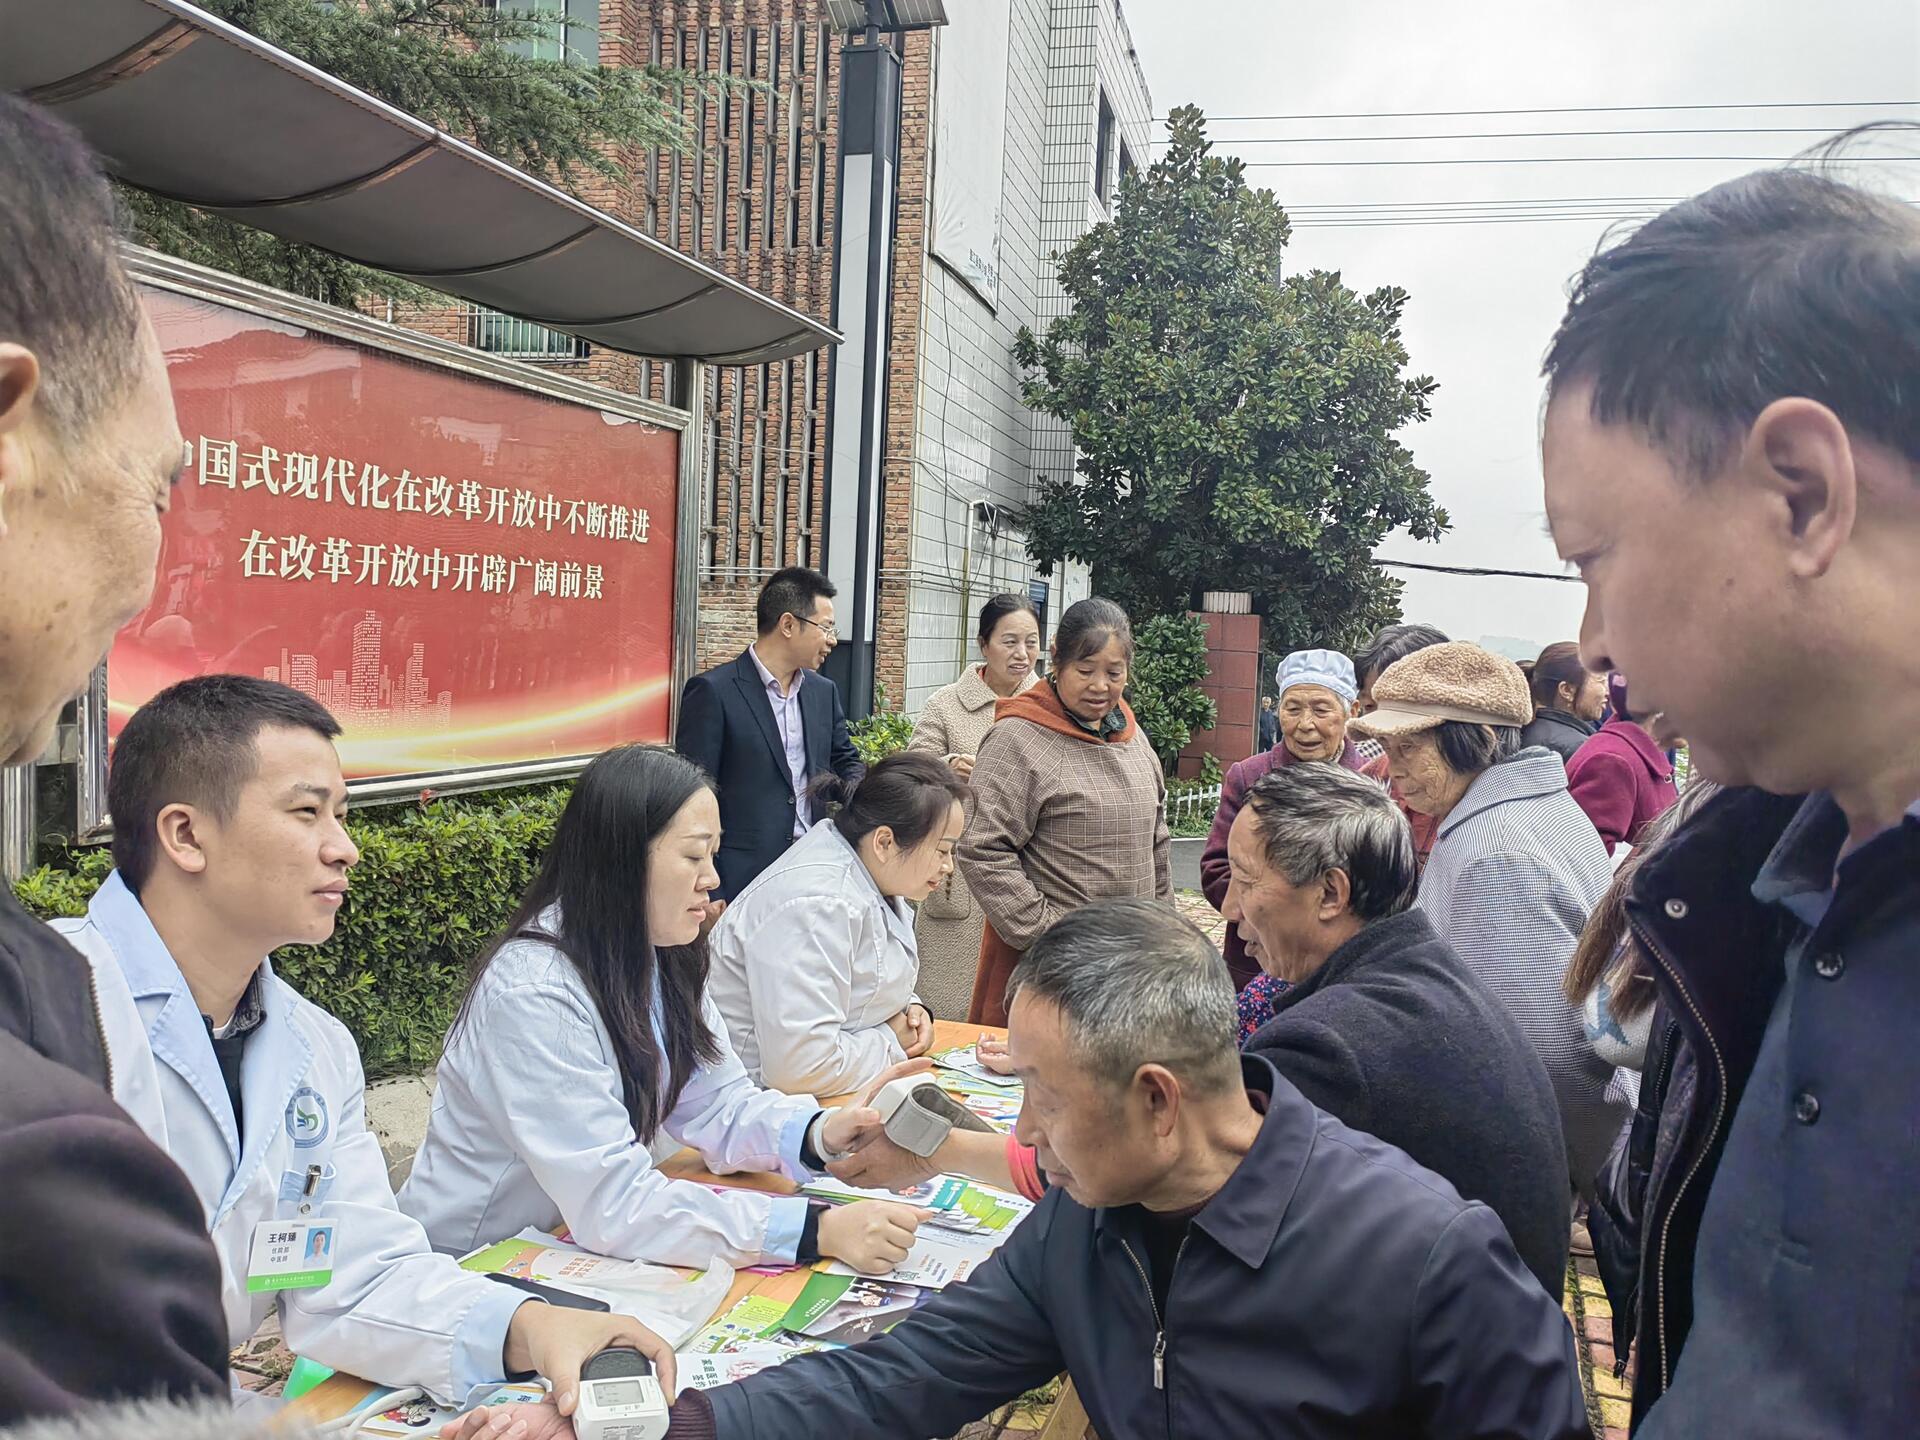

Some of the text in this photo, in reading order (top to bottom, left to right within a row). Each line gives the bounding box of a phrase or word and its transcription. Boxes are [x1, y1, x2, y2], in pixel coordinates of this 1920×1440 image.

[239, 529, 605, 599] 在改革开放中开辟广阔前景
